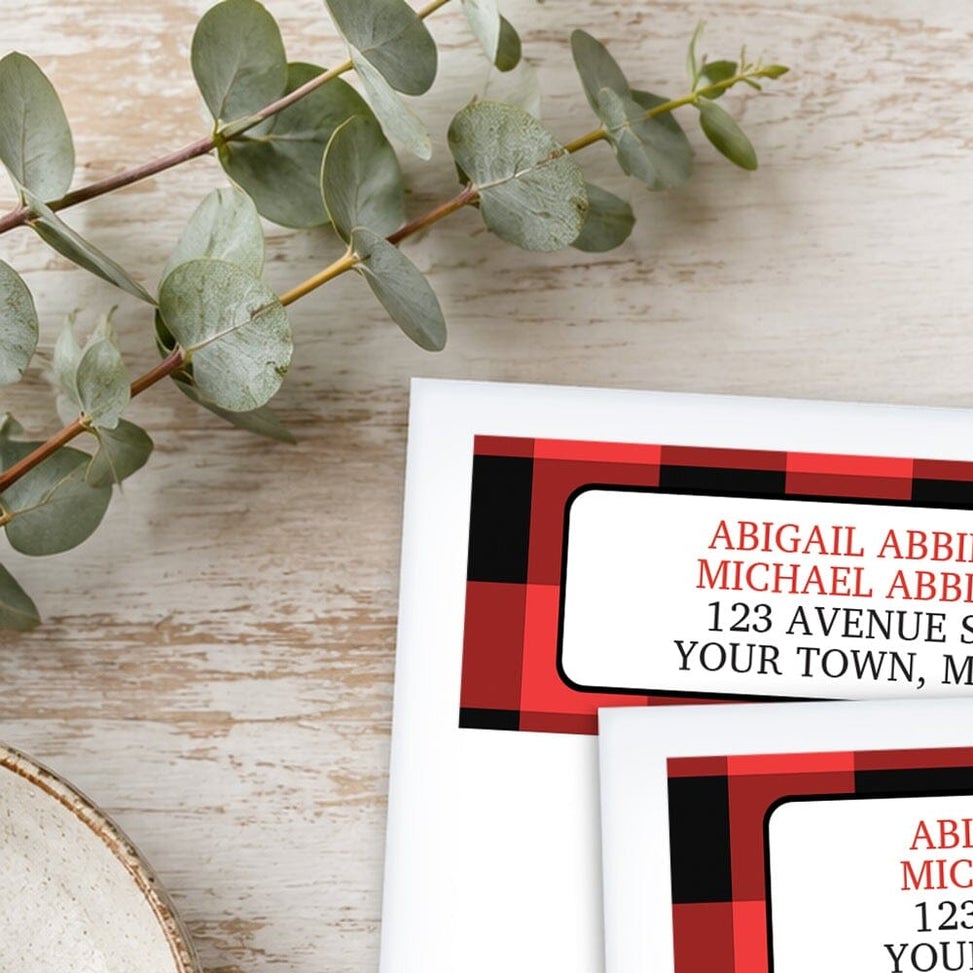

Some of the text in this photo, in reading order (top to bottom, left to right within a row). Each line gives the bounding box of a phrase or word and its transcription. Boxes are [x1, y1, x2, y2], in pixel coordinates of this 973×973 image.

[707, 519, 865, 558] ABIGAIL
[695, 558, 873, 598] MICHAEL
[708, 600, 773, 634] 123
[785, 605, 947, 643] AVENUE
[673, 639, 783, 676] YOUR
[796, 646, 926, 690] TOWN,
